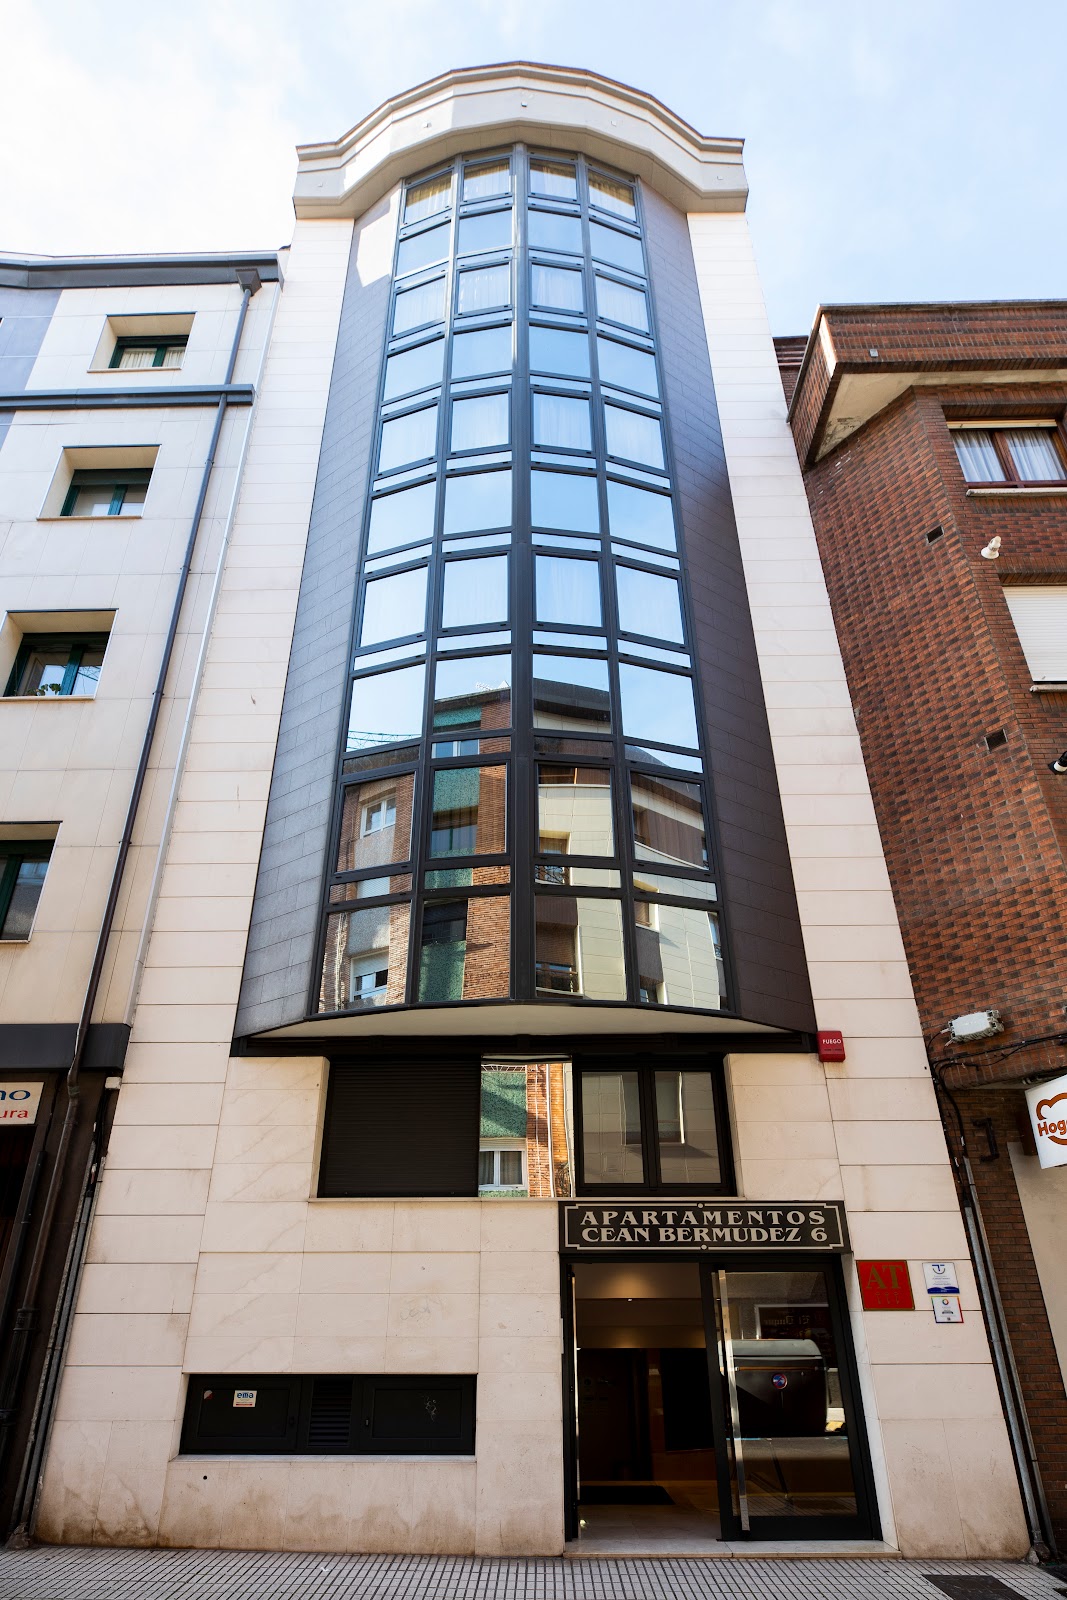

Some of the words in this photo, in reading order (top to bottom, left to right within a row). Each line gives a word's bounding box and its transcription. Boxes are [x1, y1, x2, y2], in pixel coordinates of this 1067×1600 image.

[1037, 1119, 1067, 1137] Hog
[580, 1211, 825, 1225] APARTAMENTOS
[581, 1228, 650, 1242] CEAN
[659, 1228, 802, 1242] BERMUDEZ
[810, 1228, 828, 1242] 6
[866, 1264, 904, 1289] AT
